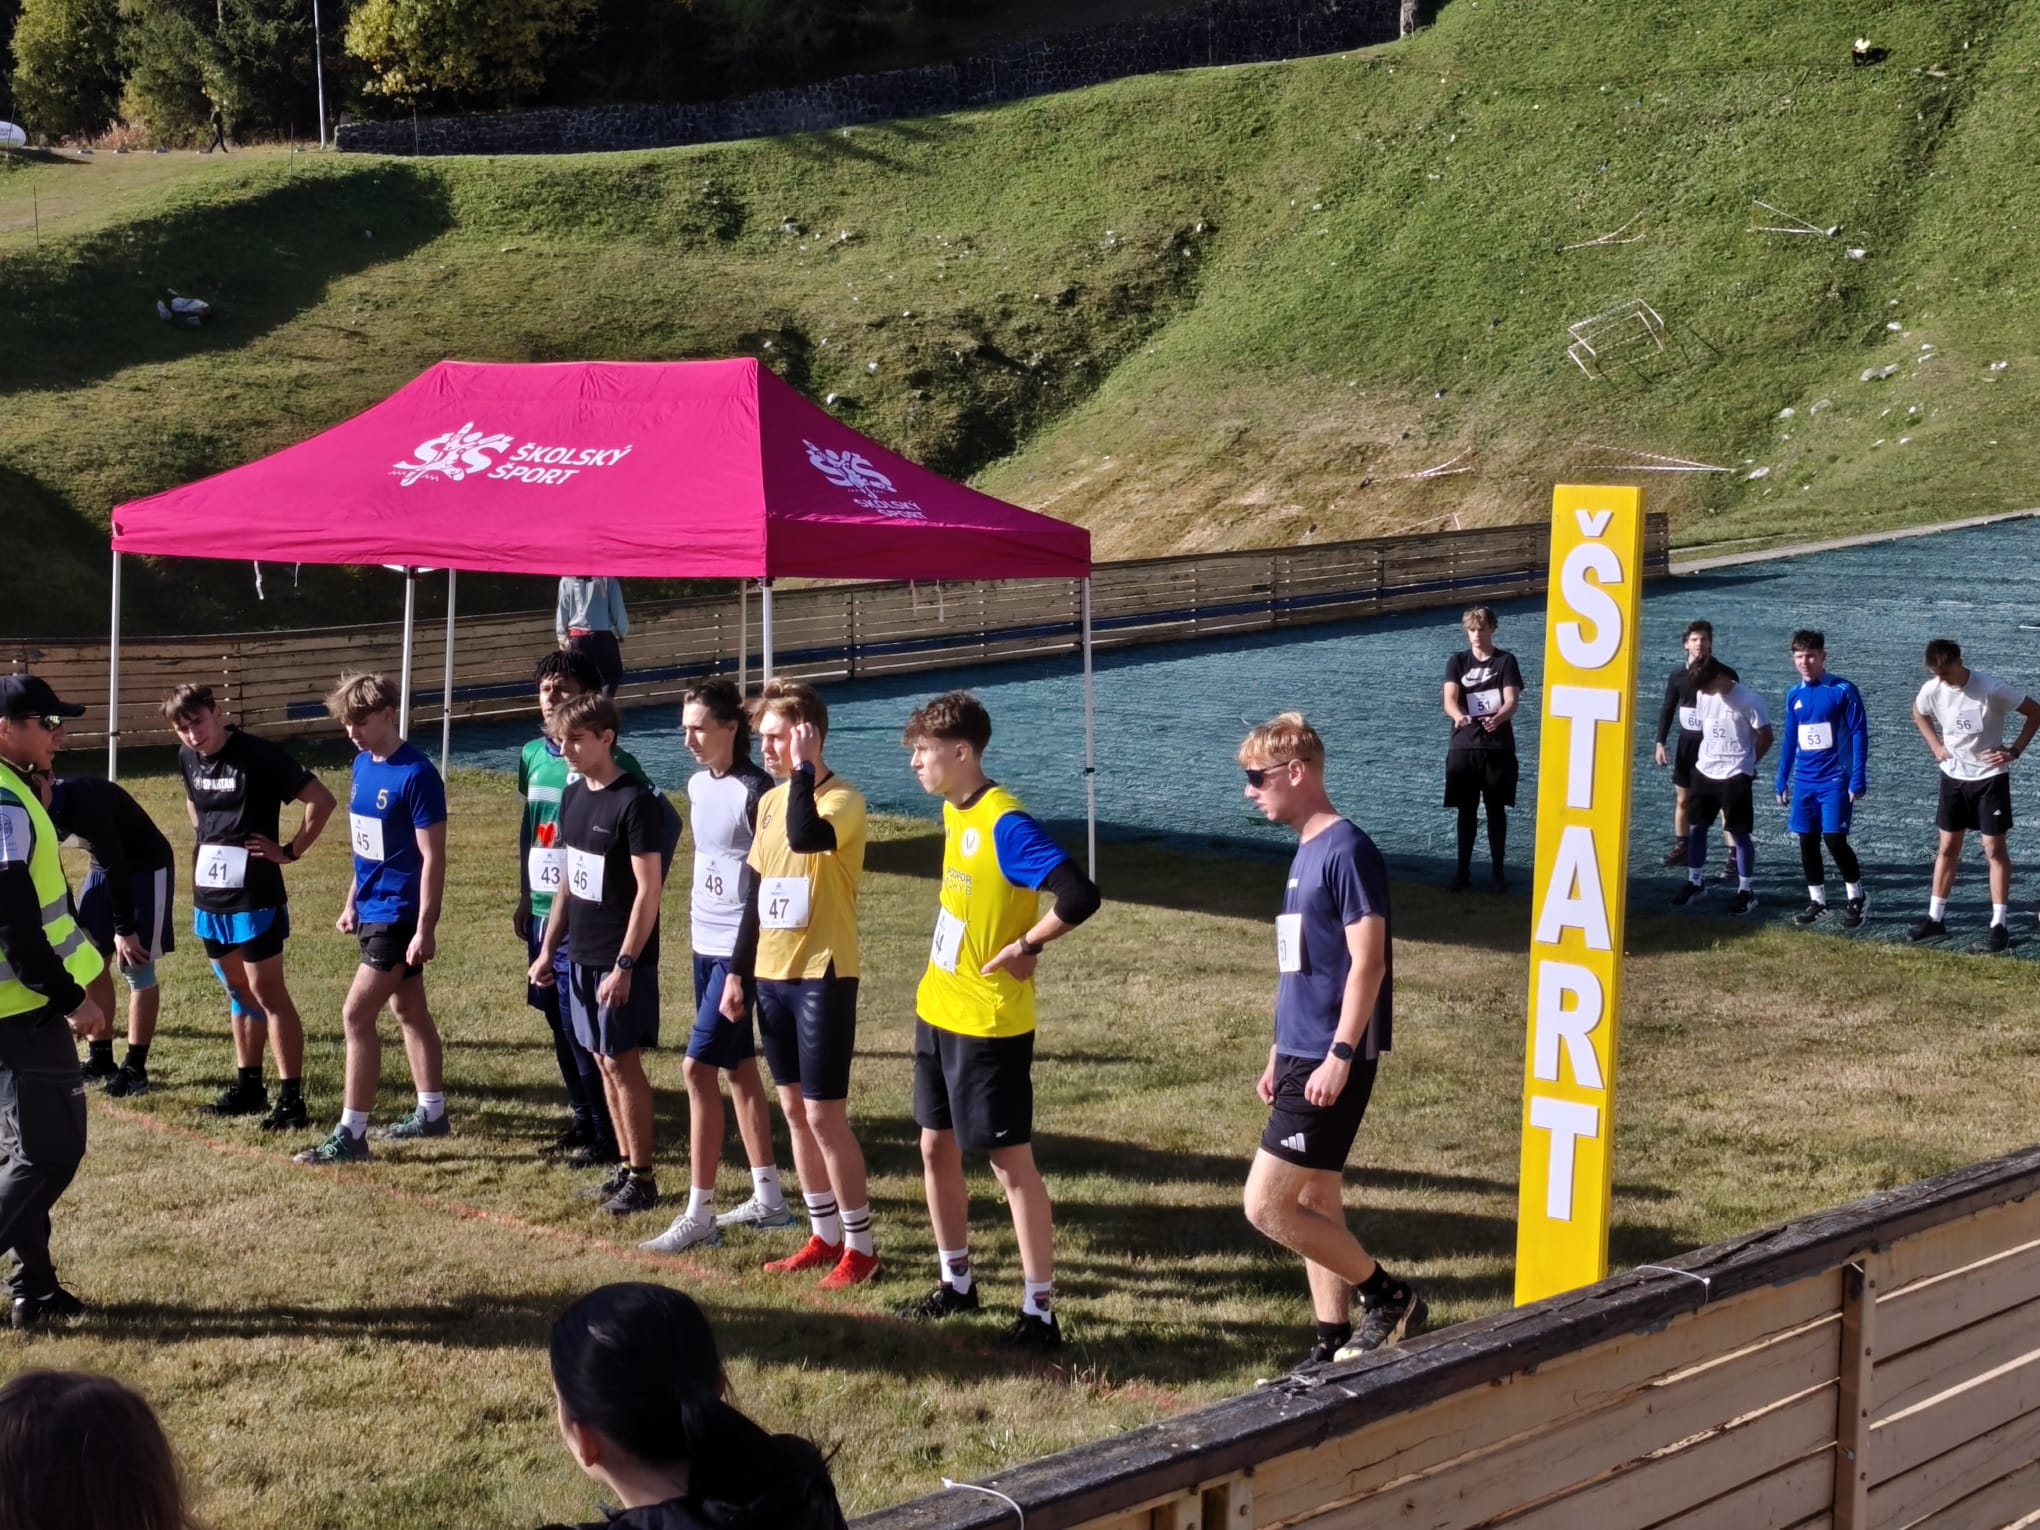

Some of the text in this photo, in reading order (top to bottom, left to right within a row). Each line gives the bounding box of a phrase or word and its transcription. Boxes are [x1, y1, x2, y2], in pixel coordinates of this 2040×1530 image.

[510, 442, 633, 466] ŠKOLSKÝ
[487, 462, 580, 485] ŠPORT
[1477, 699, 1490, 712] 51
[1712, 727, 1727, 739] 52
[1956, 720, 1972, 730] 56
[1807, 734, 1822, 745] 53
[376, 788, 389, 810] 5
[356, 831, 370, 851] 45
[208, 862, 227, 881] 41
[1530, 509, 1624, 1221] ŠTART
[541, 866, 561, 885] 43
[573, 869, 588, 890] 46
[705, 874, 724, 896] 48
[769, 898, 790, 919] 47
